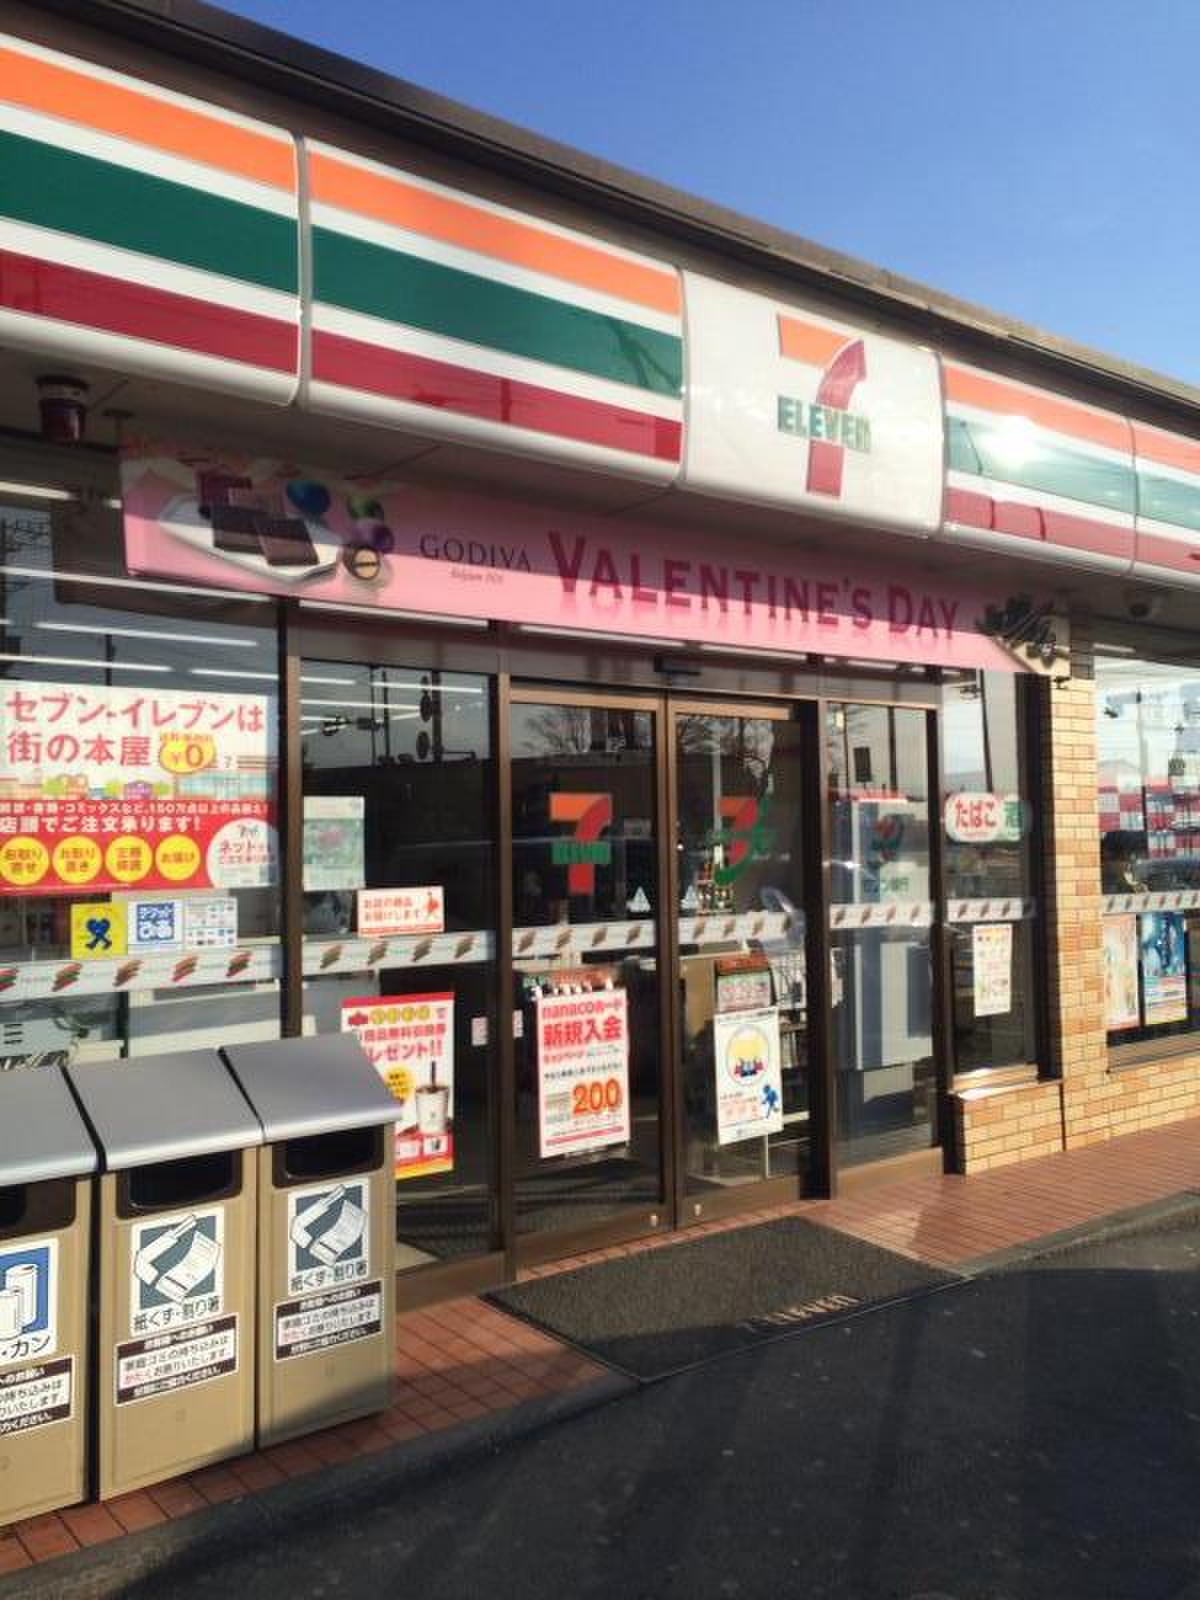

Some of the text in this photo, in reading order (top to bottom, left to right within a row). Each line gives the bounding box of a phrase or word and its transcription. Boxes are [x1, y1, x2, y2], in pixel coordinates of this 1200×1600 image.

[420, 533, 531, 573] GODIVA
[547, 530, 961, 640] VALENTINE'S DAY
[8, 731, 152, 766] 街の本屋
[956, 800, 996, 828] たばこ
[543, 1015, 623, 1049] 新規入会
[573, 1078, 621, 1116] 200
